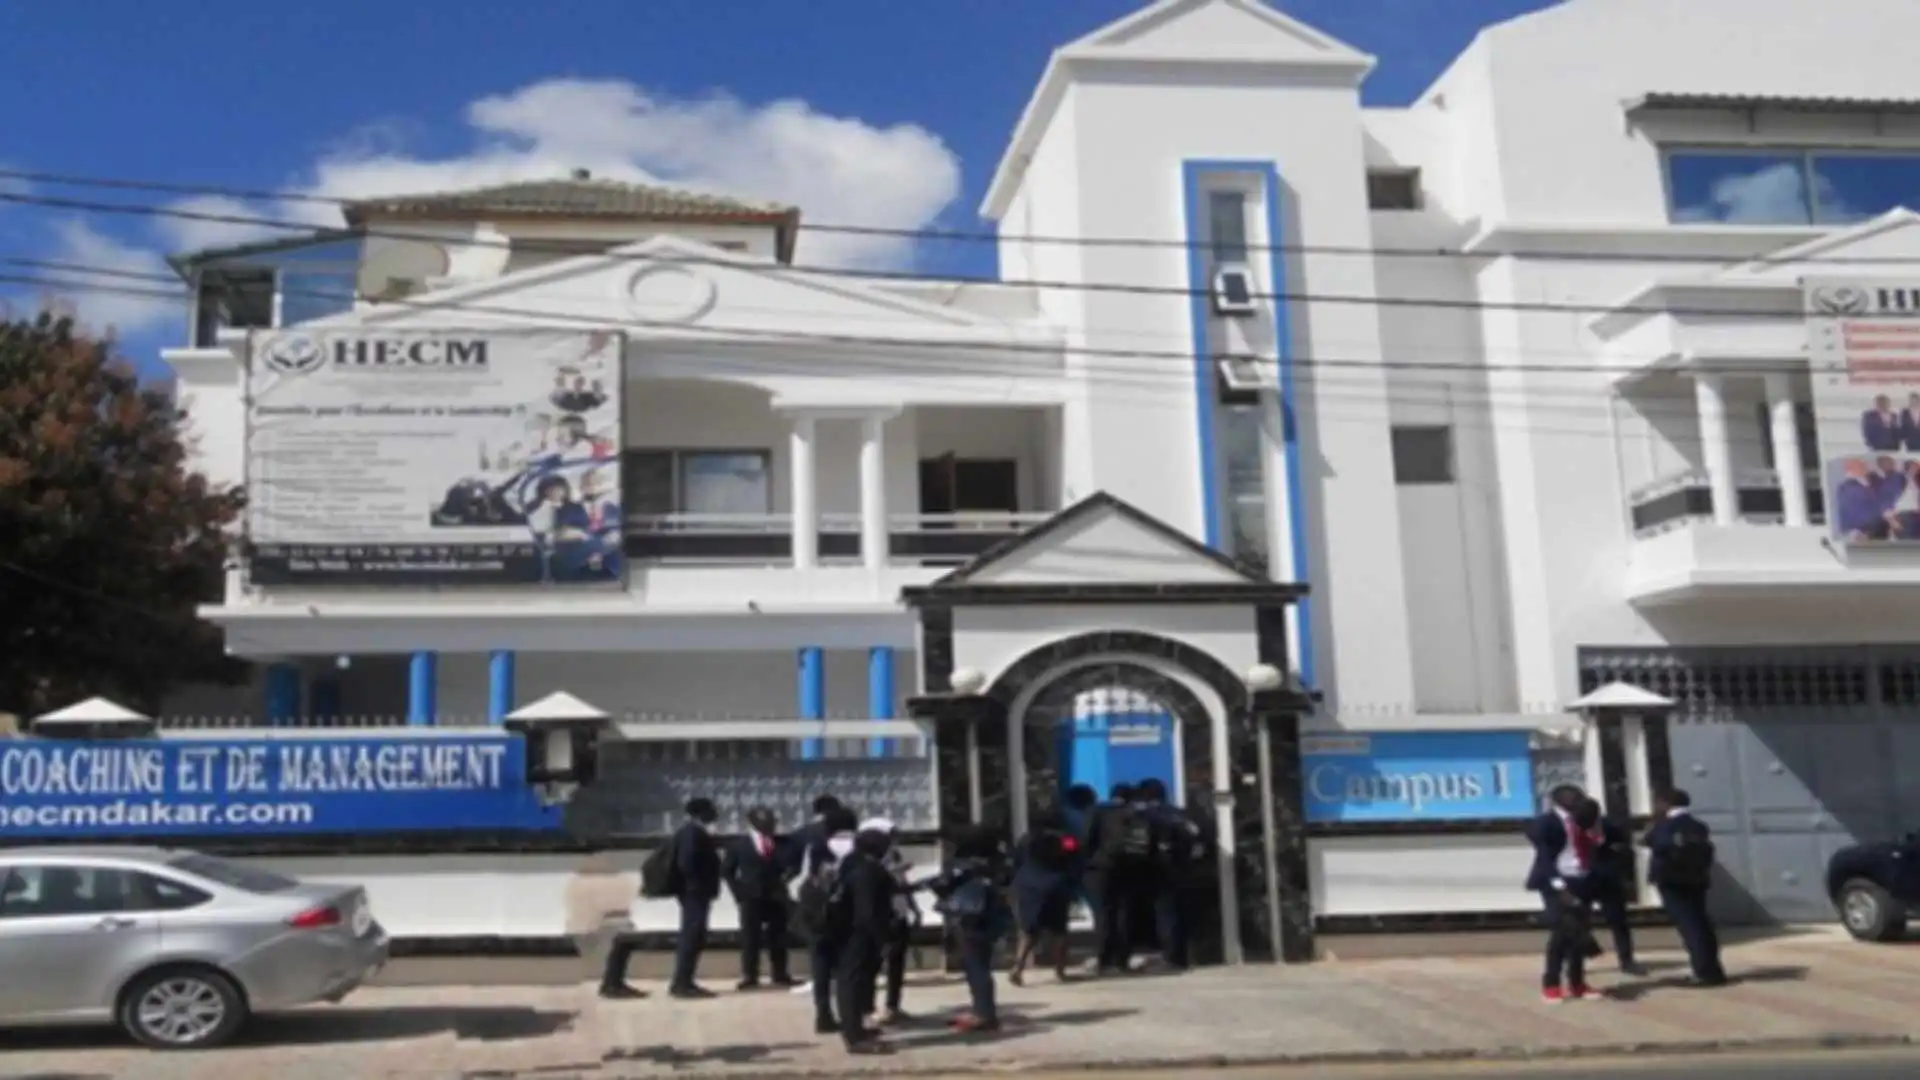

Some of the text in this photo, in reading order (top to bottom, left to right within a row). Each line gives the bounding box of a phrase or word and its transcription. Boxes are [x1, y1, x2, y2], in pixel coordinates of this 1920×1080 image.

[333, 339, 490, 366] HECM
[1, 743, 507, 794] COACHING ET DE MANAGEMENT
[1308, 761, 1483, 813] Campus
